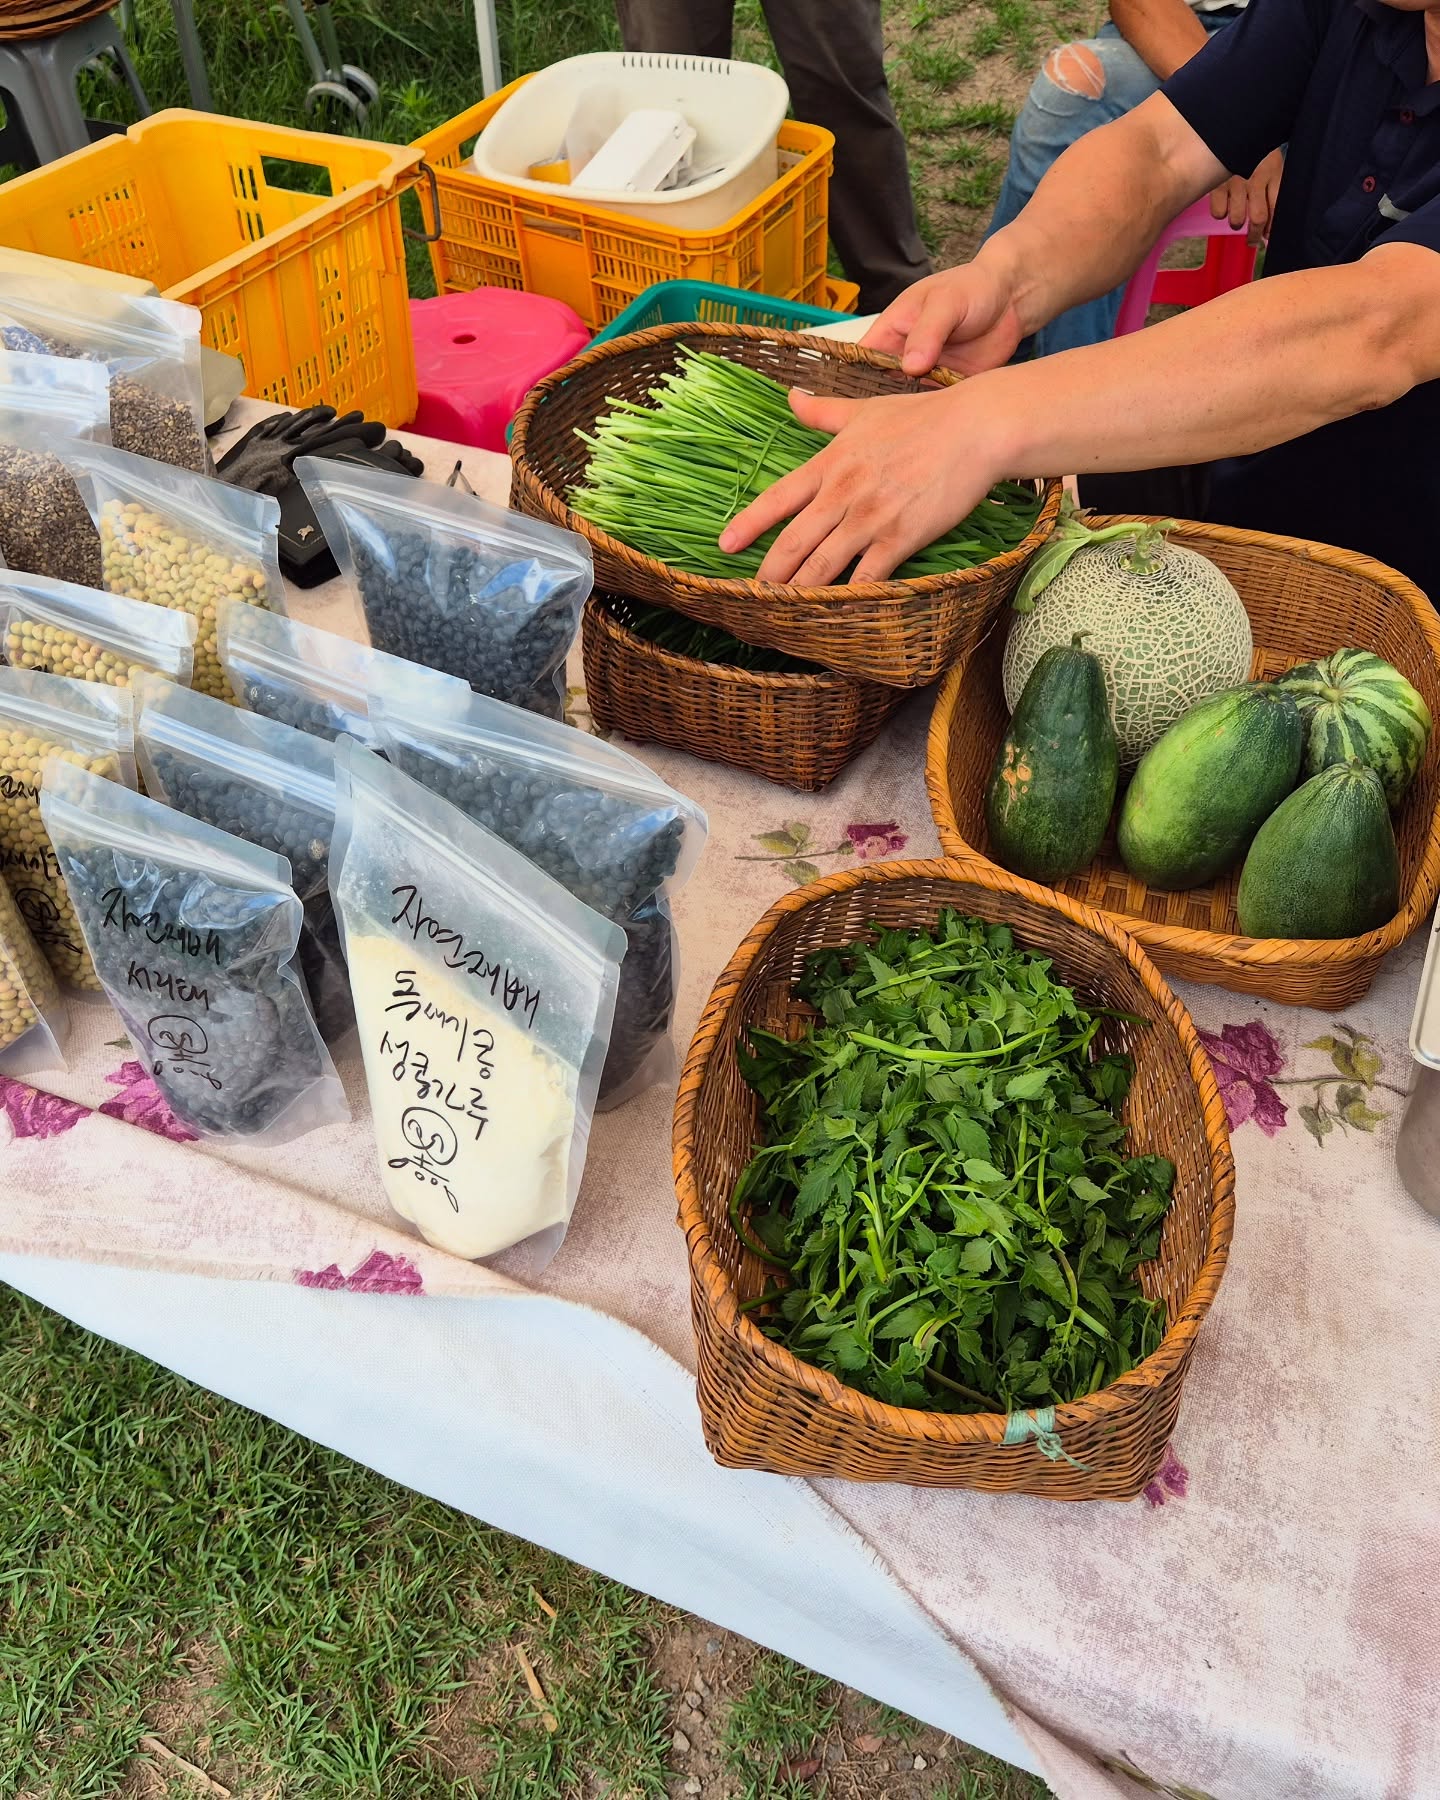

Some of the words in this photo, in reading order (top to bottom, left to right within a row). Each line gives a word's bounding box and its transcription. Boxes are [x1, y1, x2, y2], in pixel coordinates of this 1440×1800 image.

[101, 887, 221, 966] 자연재배
[391, 884, 541, 1029] 자연재배
[127, 960, 210, 1011] 서리태
